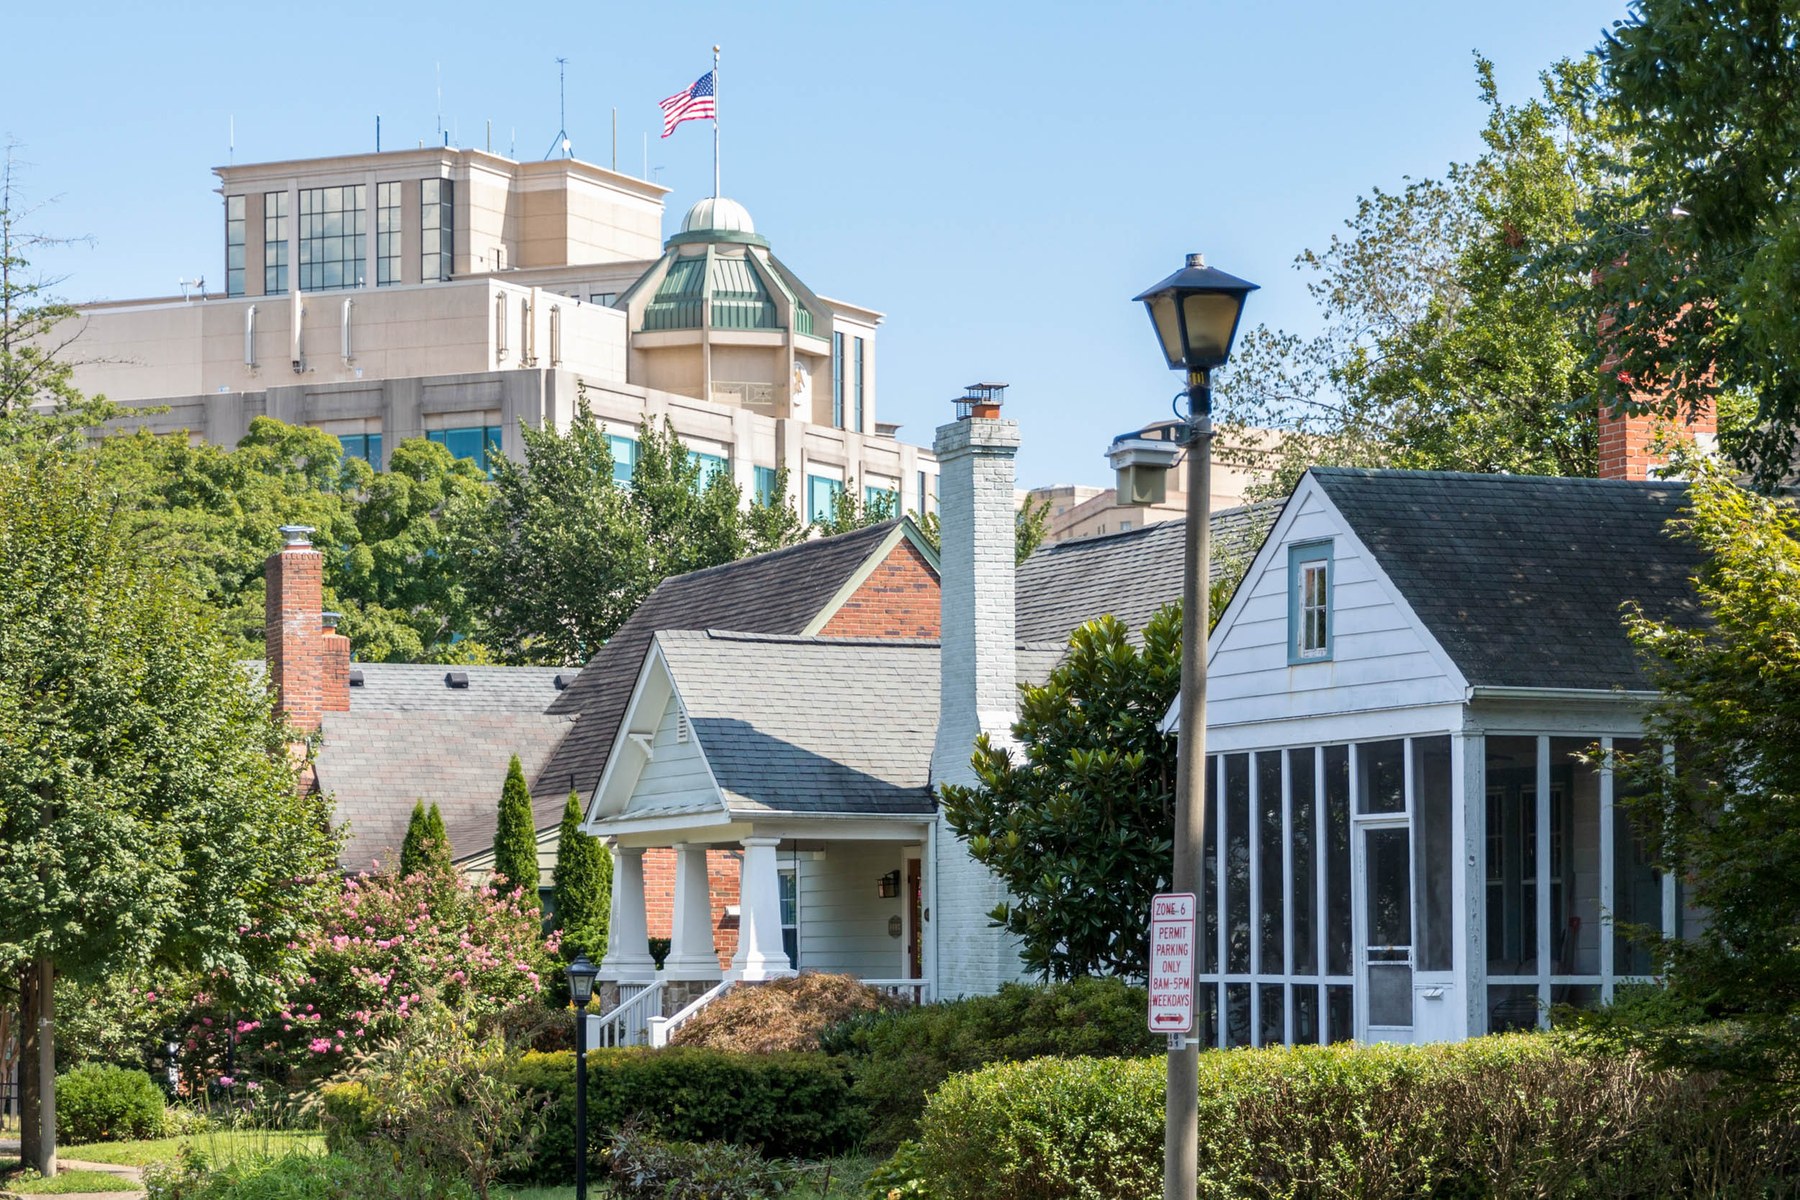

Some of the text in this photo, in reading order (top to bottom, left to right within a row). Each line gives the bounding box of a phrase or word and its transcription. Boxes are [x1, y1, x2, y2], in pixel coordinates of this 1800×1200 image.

[1156, 902, 1186, 915] ZONE 6
[1159, 926, 1187, 939] PERMIT
[1156, 943, 1188, 956] PARKING
[1162, 960, 1181, 973] ONLY
[1153, 977, 1189, 990] 8AM-5PM
[1152, 994, 1190, 1007] WEEKDAYS
